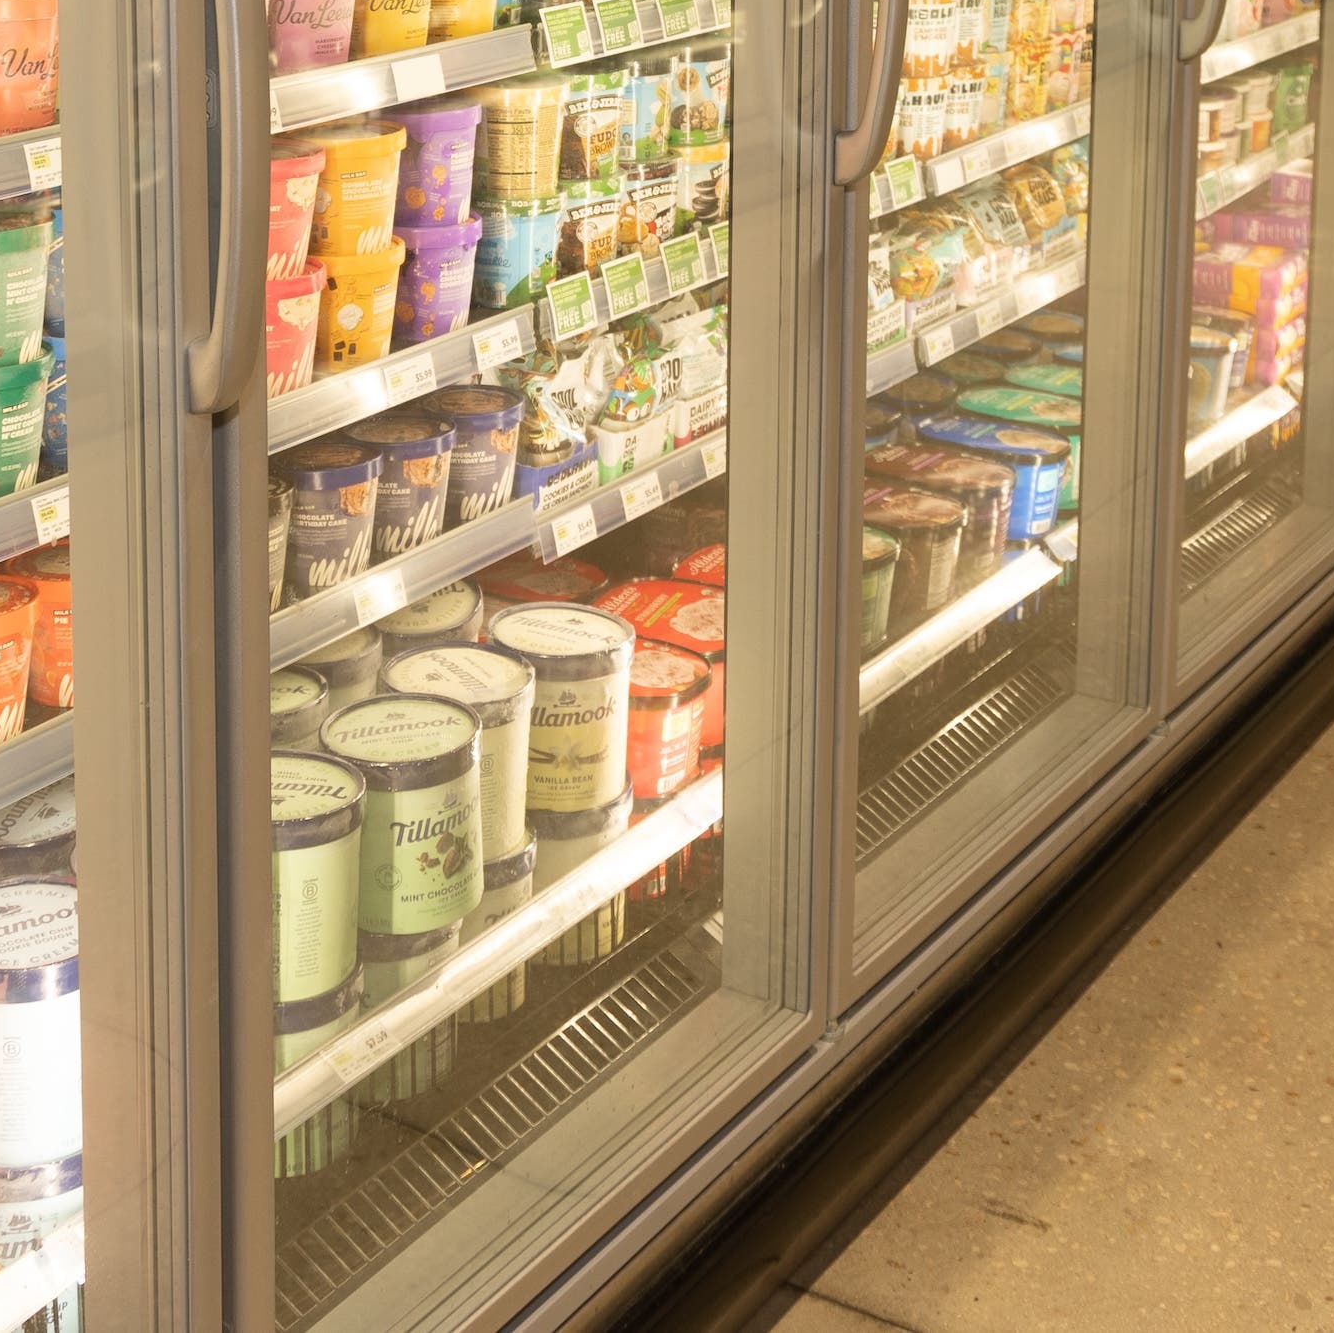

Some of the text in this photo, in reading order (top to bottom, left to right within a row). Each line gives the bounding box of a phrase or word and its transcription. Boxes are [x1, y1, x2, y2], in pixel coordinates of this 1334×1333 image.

[613, 294, 635, 310] FREE
[558, 316, 581, 330] FREE
[336, 716, 461, 741] Tillamook
[534, 774, 565, 785] VANILLA
[401, 893, 425, 903] MINT
[50, 924, 75, 935] CHIP
[30, 935, 73, 948] DOUGH
